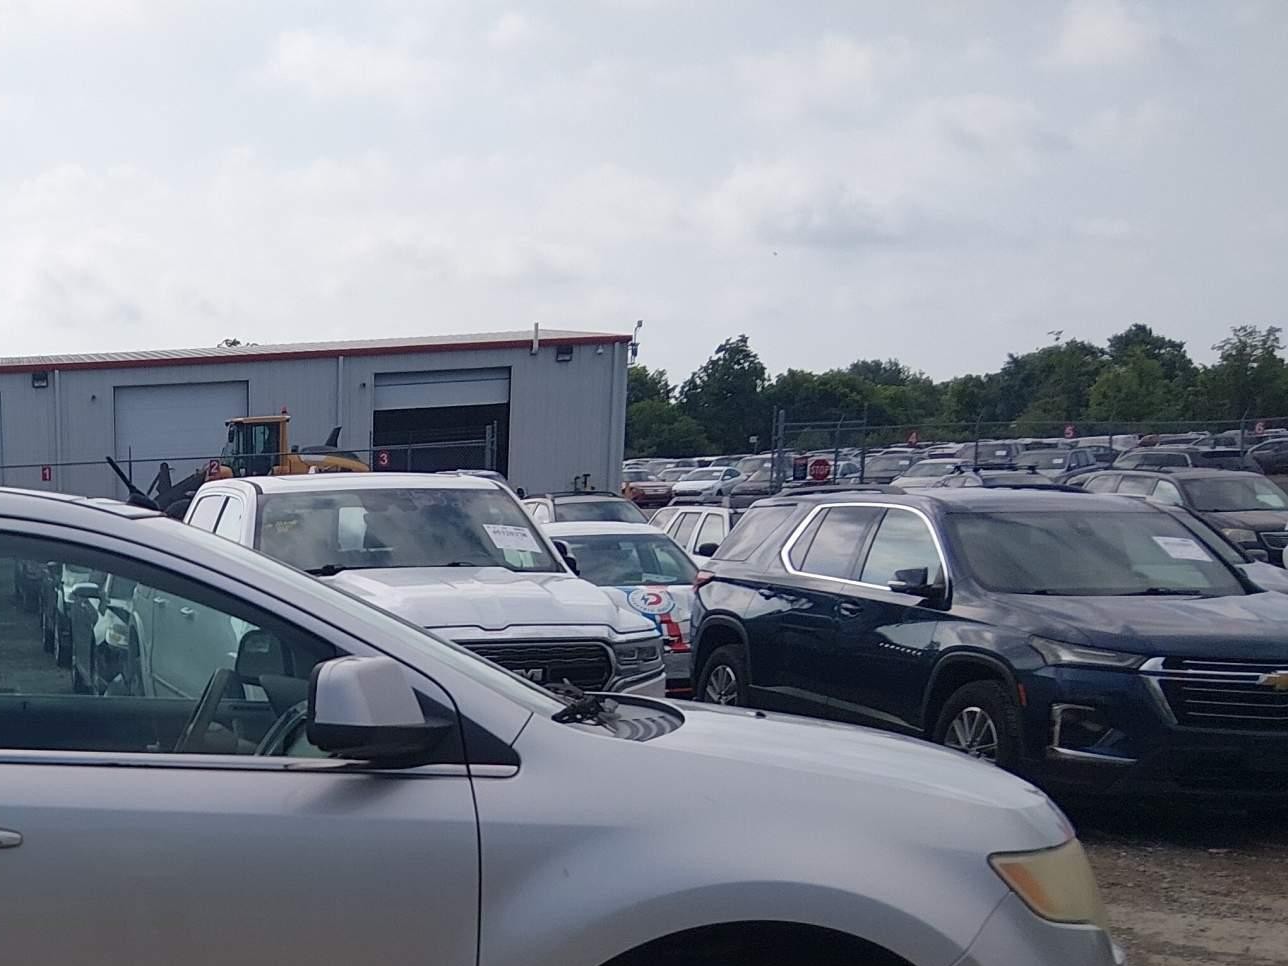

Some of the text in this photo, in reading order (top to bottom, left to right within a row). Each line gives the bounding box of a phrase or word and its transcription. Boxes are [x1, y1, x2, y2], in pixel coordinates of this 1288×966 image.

[908, 431, 917, 443] 4
[379, 453, 388, 465] 3
[211, 460, 218, 473] 2
[810, 465, 830, 475] STOP
